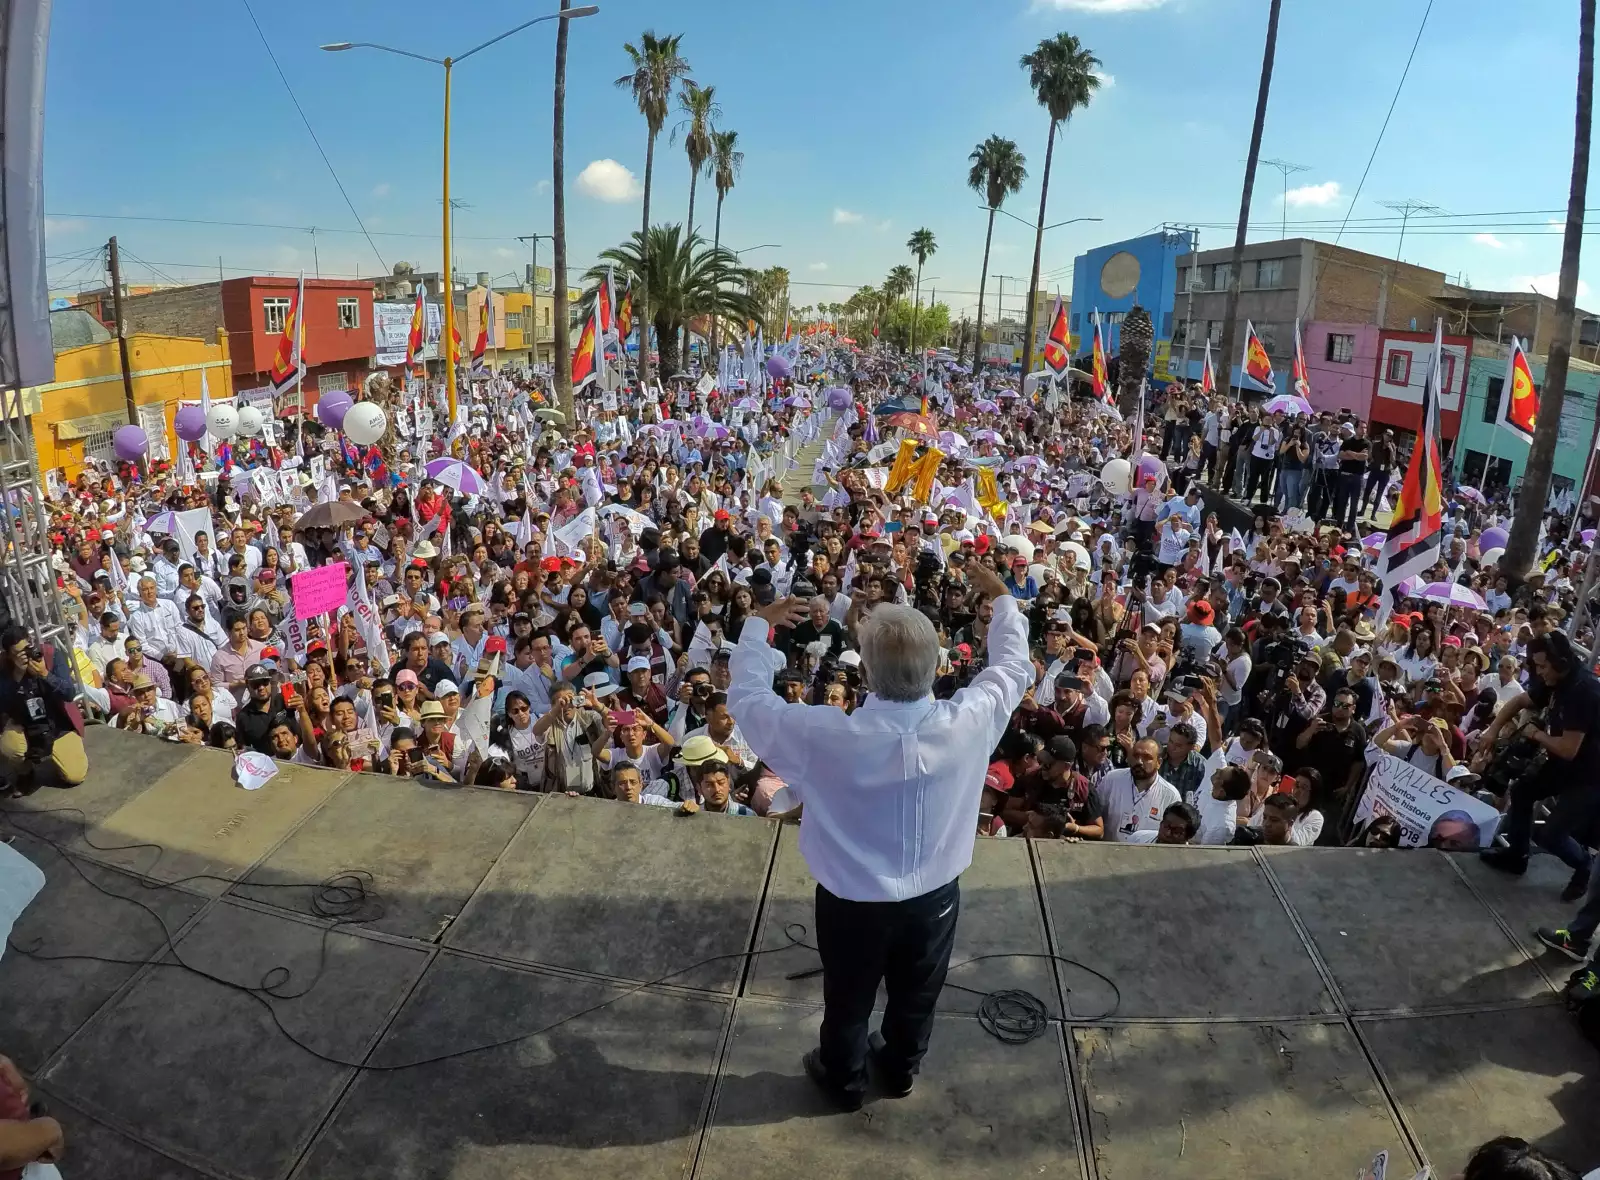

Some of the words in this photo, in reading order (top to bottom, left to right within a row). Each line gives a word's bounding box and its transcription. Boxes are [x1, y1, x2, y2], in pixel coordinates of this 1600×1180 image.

[1390, 782, 1417, 802] Juntos
[1401, 797, 1432, 822] historia
[1399, 826, 1420, 844] 018
